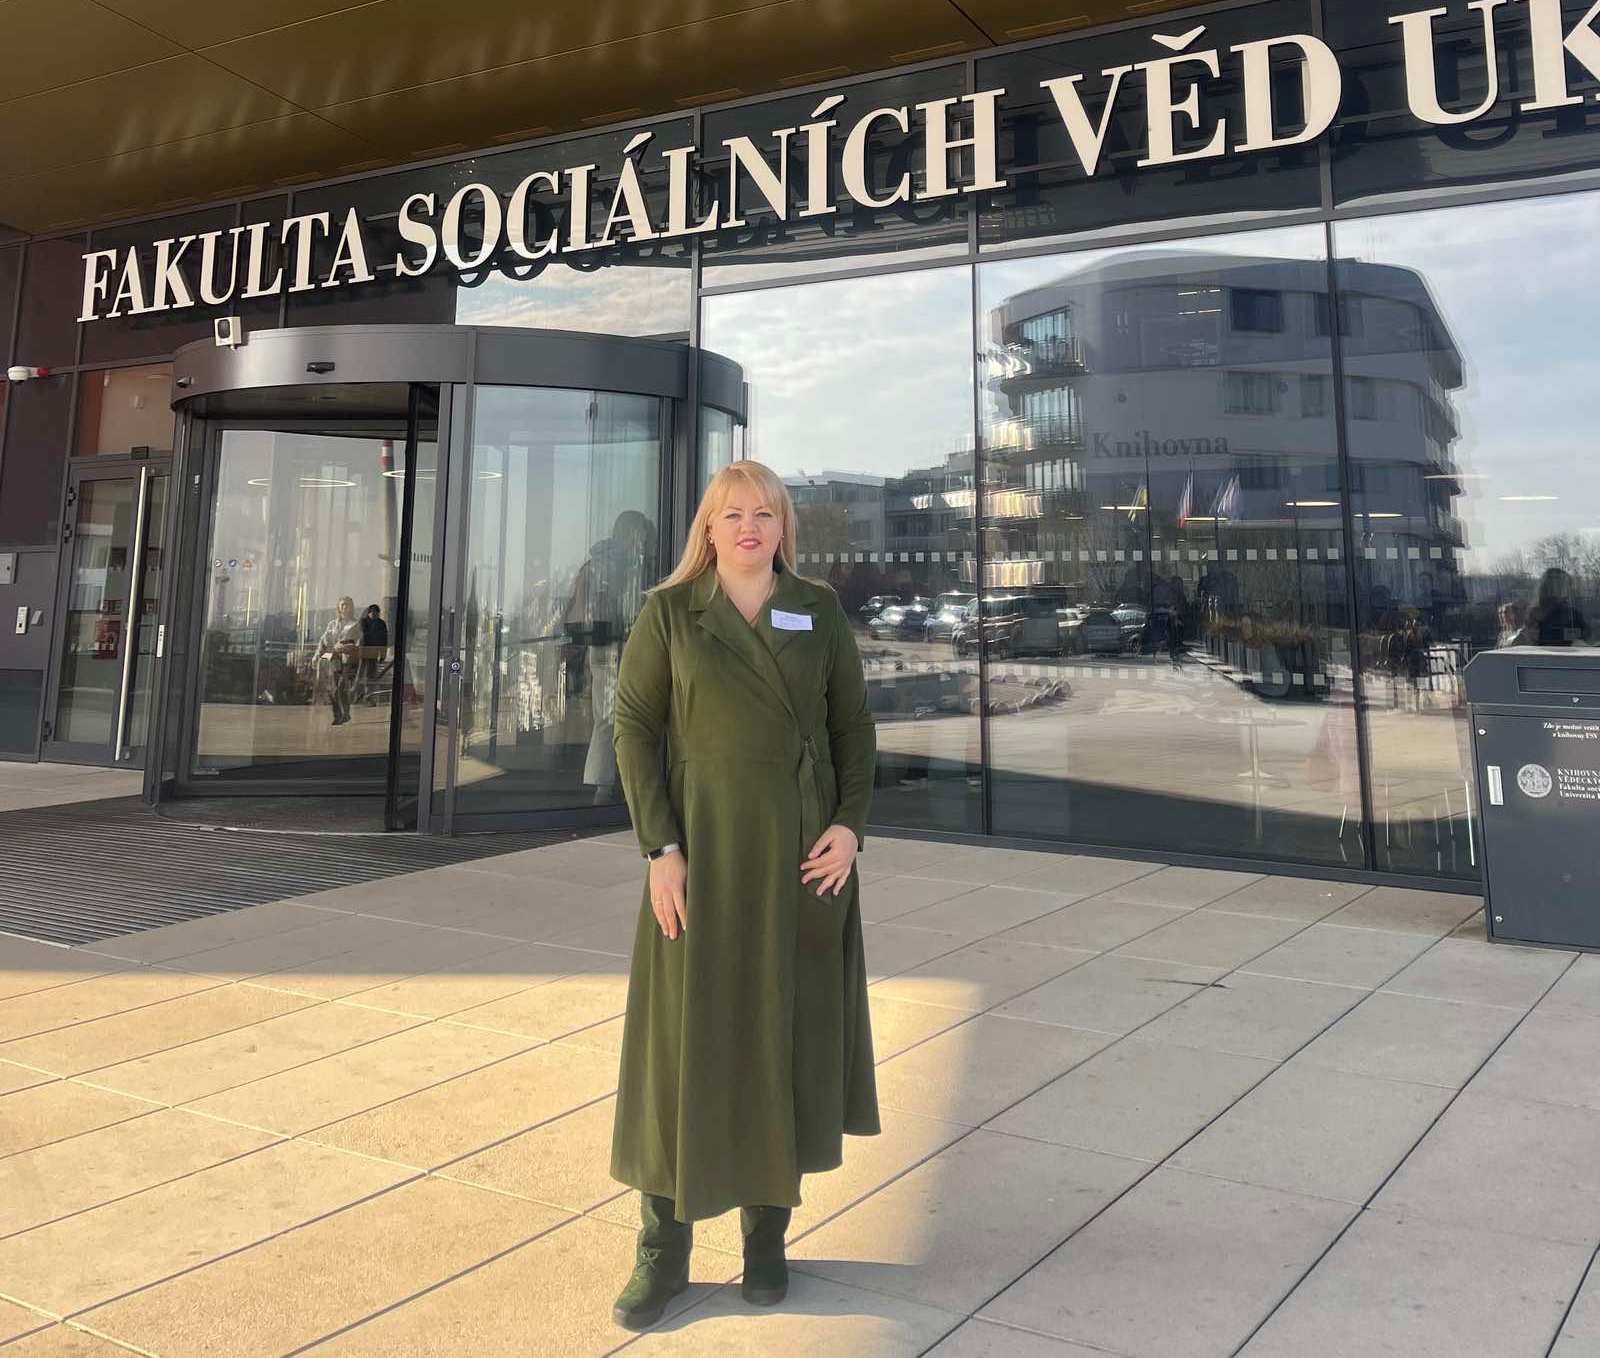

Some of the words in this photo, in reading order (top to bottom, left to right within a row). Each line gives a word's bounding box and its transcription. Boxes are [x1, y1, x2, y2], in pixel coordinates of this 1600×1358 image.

[77, 207, 375, 323] FAKULTA
[395, 88, 1007, 277] SOCIÁLNÍCH
[1039, 24, 1342, 177] VĚD
[1388, 0, 1600, 124] UK
[1091, 430, 1231, 458] Knihovna
[1557, 768, 1600, 777] KNIHOVN
